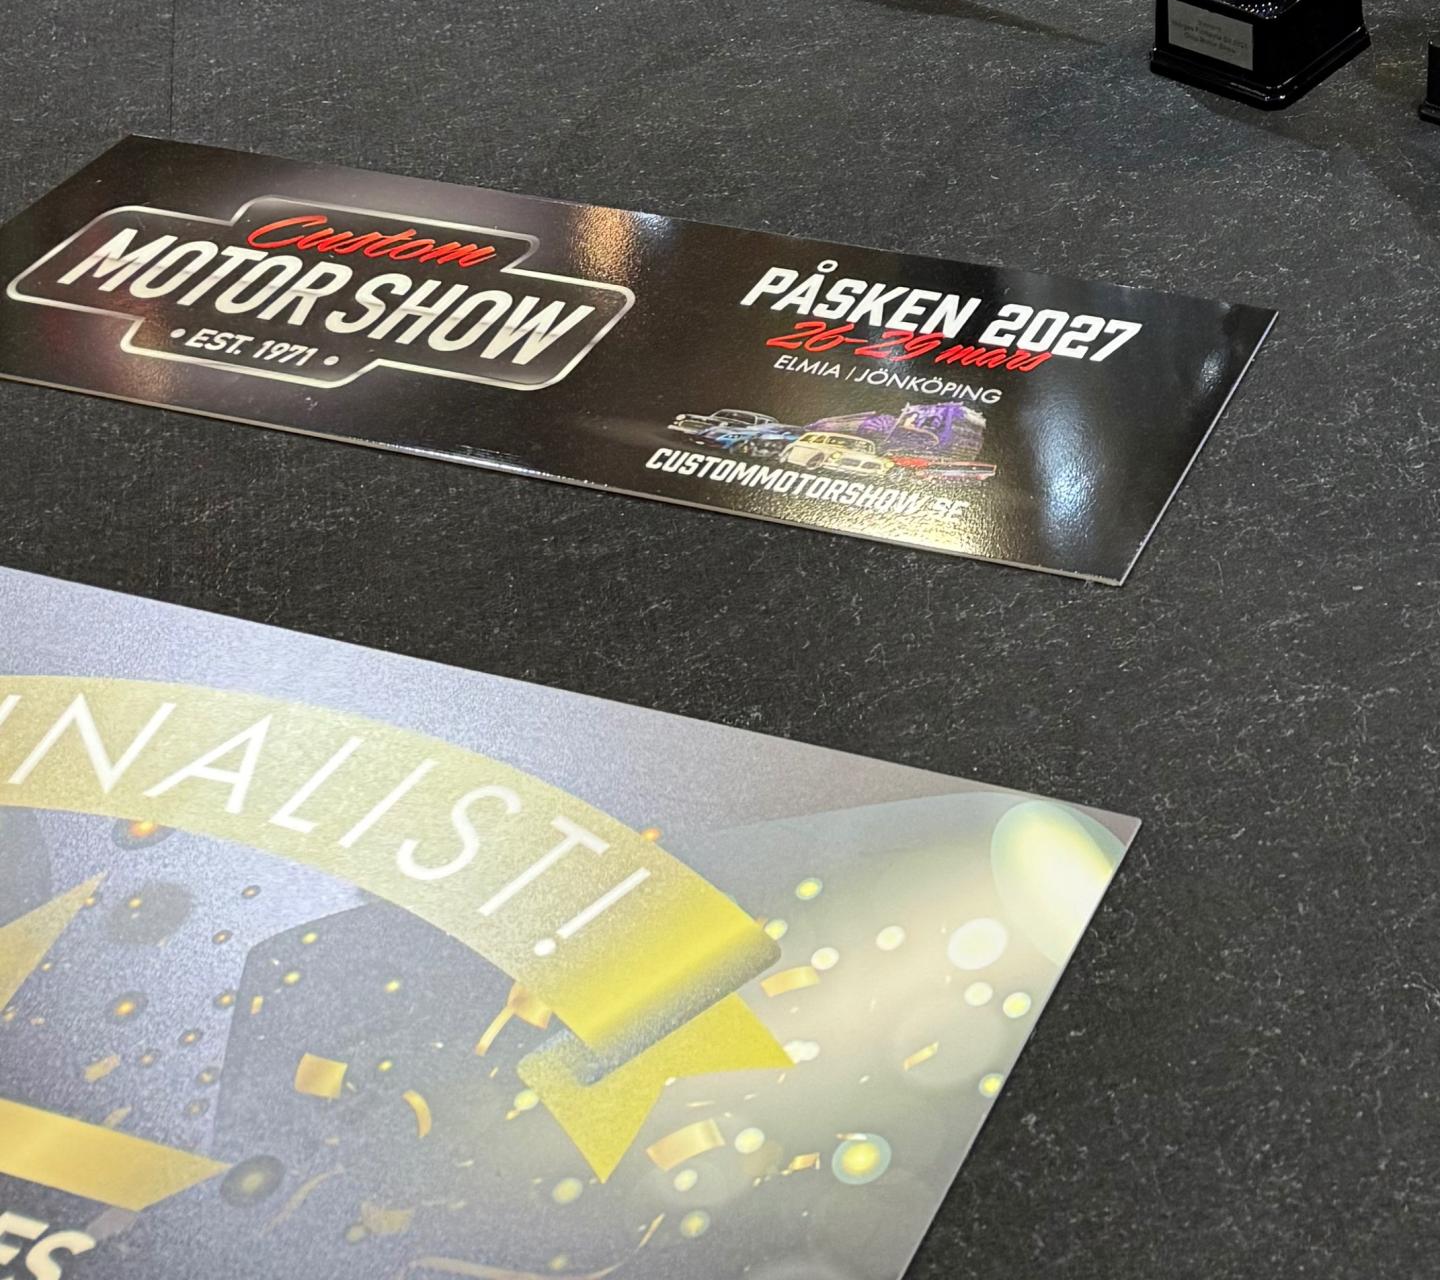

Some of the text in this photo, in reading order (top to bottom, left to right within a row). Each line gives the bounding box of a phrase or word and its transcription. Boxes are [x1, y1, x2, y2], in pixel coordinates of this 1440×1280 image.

[246, 213, 498, 268] Custom
[56, 226, 596, 367] MOTOR SHOW
[740, 259, 1144, 365] PÅSKEN 2027
[184, 328, 319, 367] EST. 1971
[766, 320, 1054, 374] 26-29 mars
[773, 353, 1004, 405] ELMIA JÖNKÖPING
